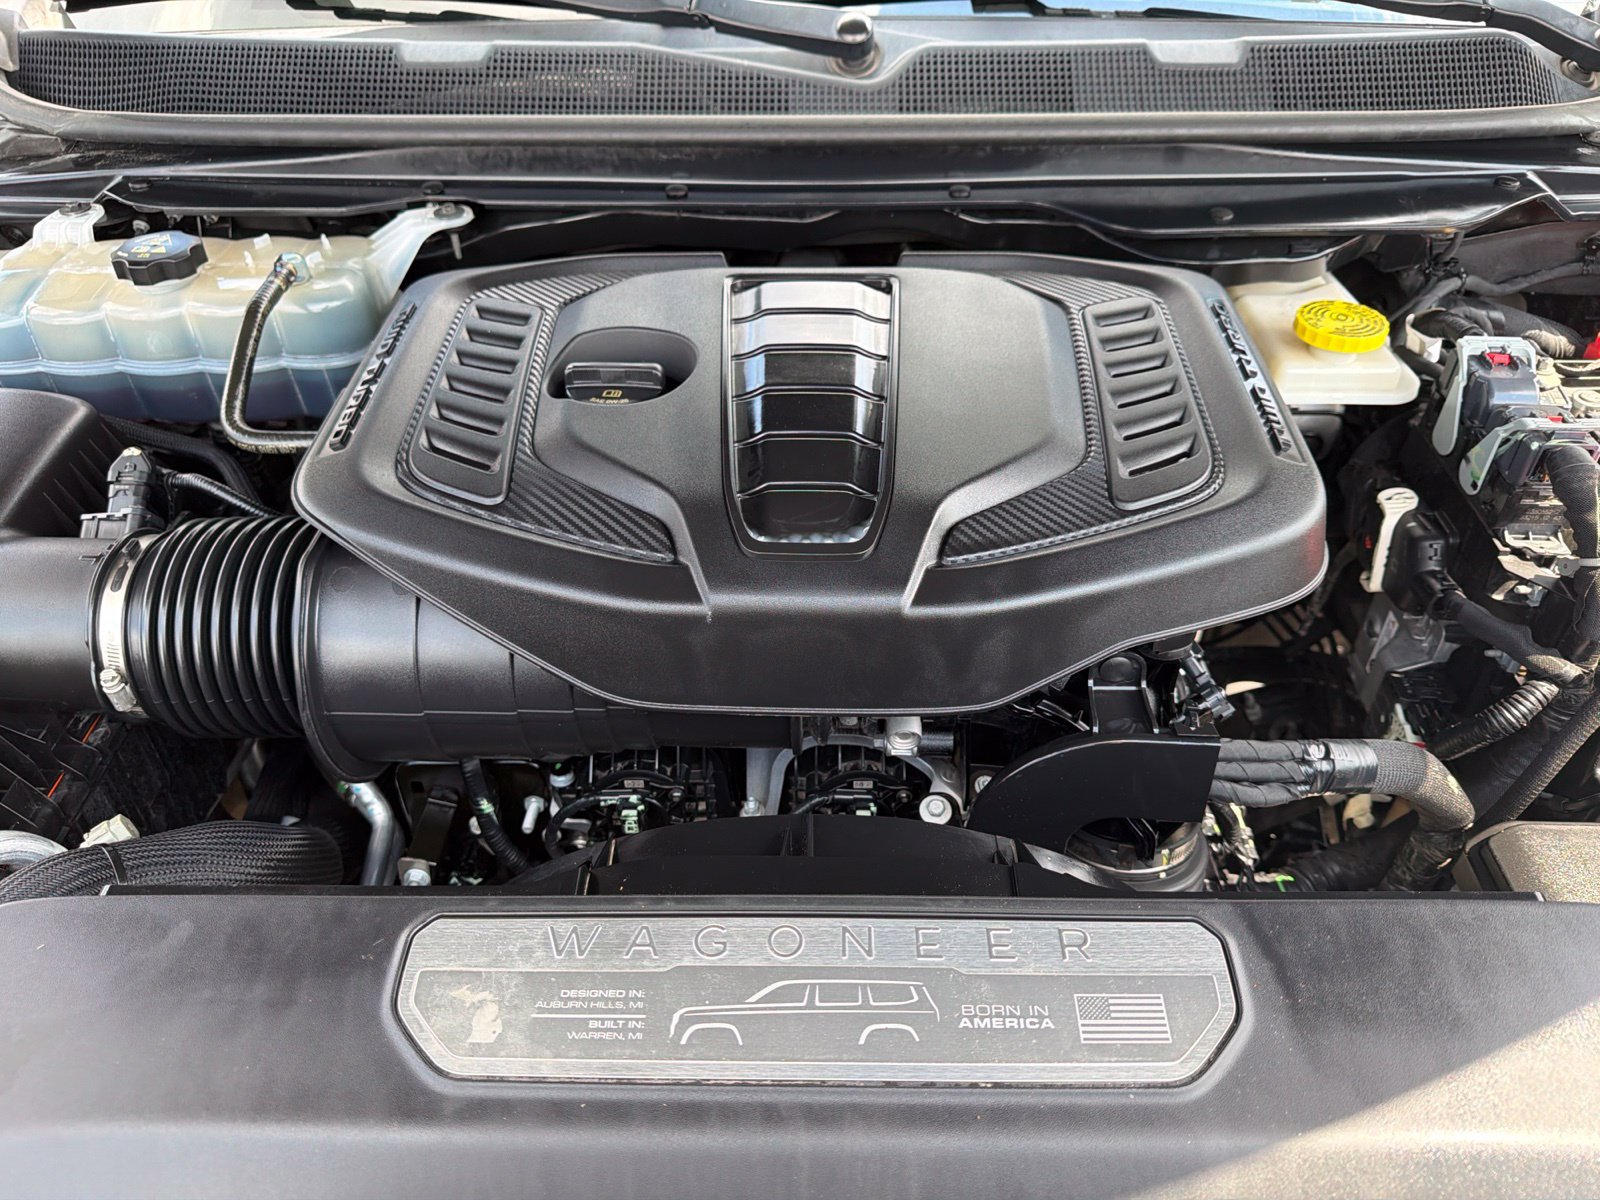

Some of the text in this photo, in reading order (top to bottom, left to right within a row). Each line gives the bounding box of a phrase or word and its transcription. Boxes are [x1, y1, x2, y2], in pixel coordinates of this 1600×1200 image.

[1210, 302, 1258, 382] TURBO
[329, 359, 386, 451] TURBO
[547, 924, 1093, 962] WAGONEER
[560, 989, 646, 998] DESIGNED IN:
[534, 1001, 644, 1010] AUBURN HILLS, MI
[961, 1004, 1049, 1016] BORN IN
[588, 1020, 646, 1029] BUILT IN:
[958, 1017, 1056, 1029] AMERICA
[566, 1031, 643, 1041] WARREN, MI
